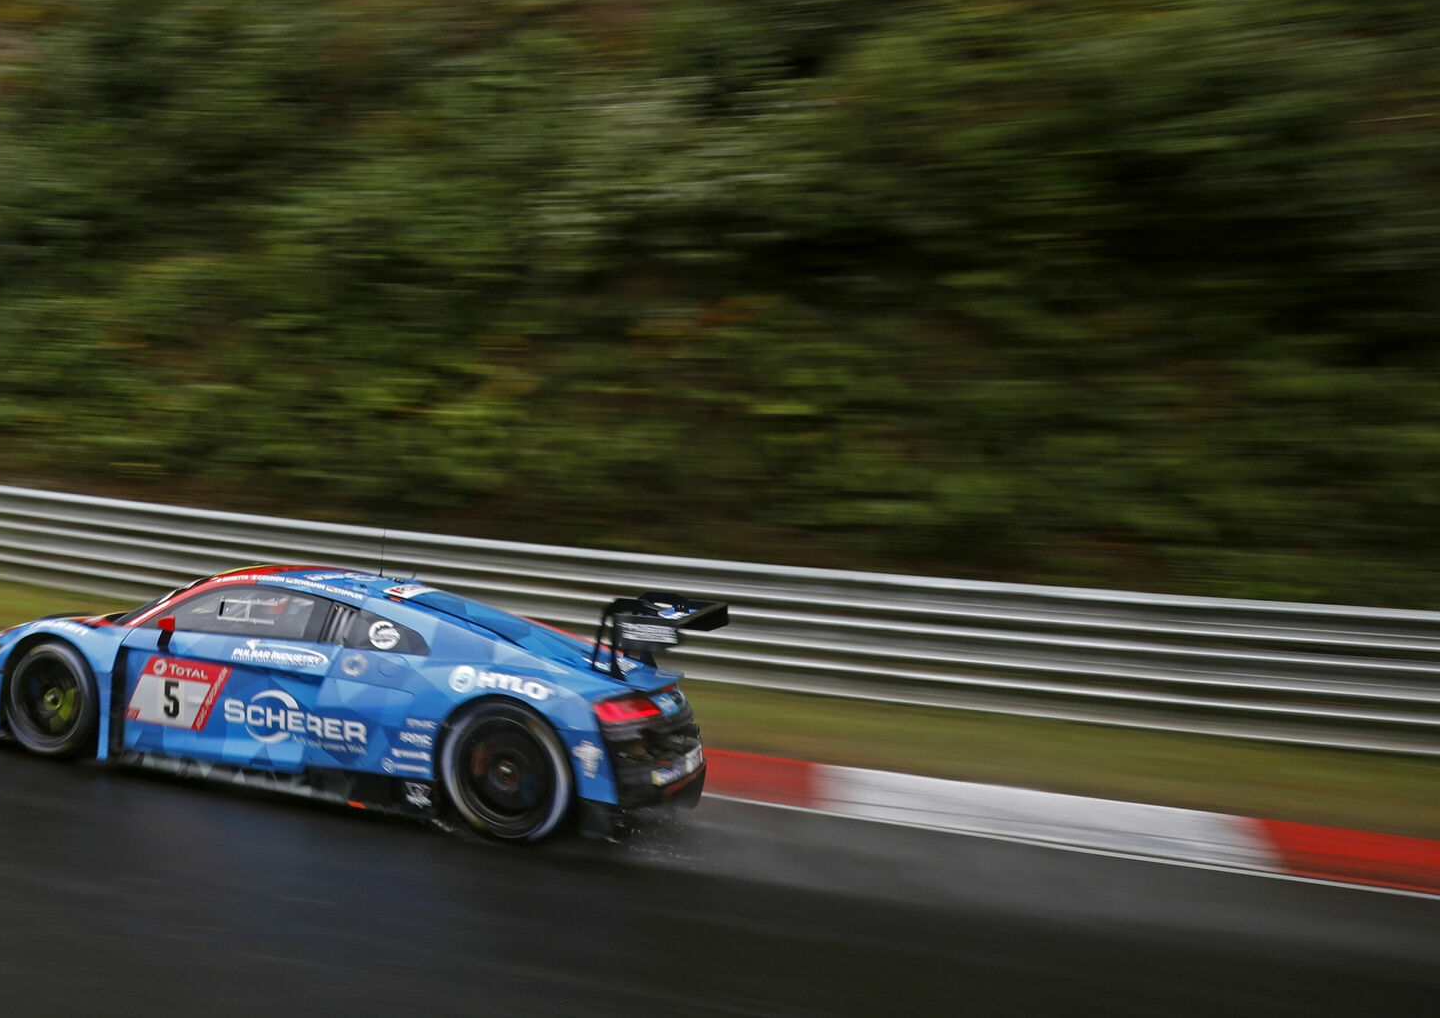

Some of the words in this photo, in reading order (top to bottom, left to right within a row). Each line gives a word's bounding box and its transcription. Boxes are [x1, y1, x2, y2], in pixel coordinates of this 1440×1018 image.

[168, 663, 208, 680] TOTAL
[164, 679, 180, 719] 5
[224, 698, 367, 745] SCHERER
